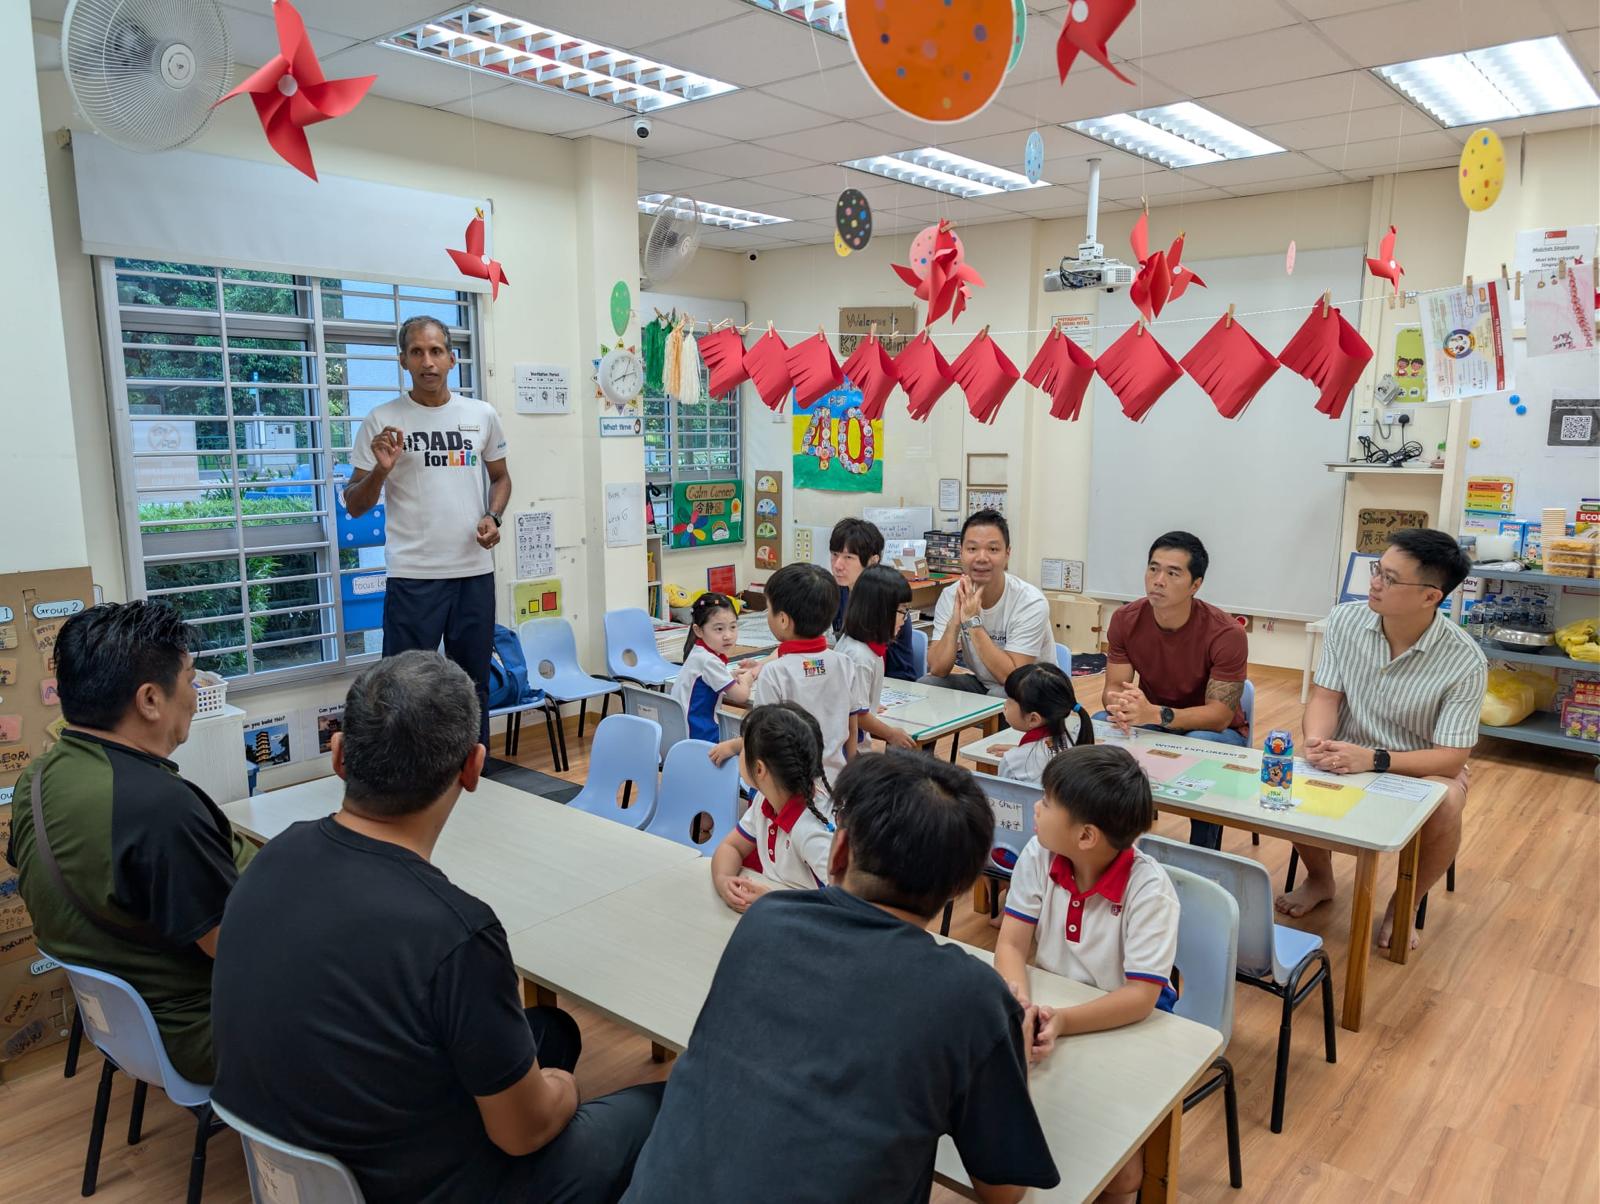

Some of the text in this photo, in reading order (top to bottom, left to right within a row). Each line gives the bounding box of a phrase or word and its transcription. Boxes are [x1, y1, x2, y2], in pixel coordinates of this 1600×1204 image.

[602, 423, 633, 432] What time
[411, 431, 474, 452] DADs
[801, 406, 875, 474] 40
[424, 450, 478, 467] forLife
[5, 607, 11, 619] 1
[36, 602, 79, 617] Group 2
[251, 721, 260, 729] you
[261, 718, 273, 726] build
[0, 750, 30, 763] EORA
[32, 960, 59, 972] Grou
